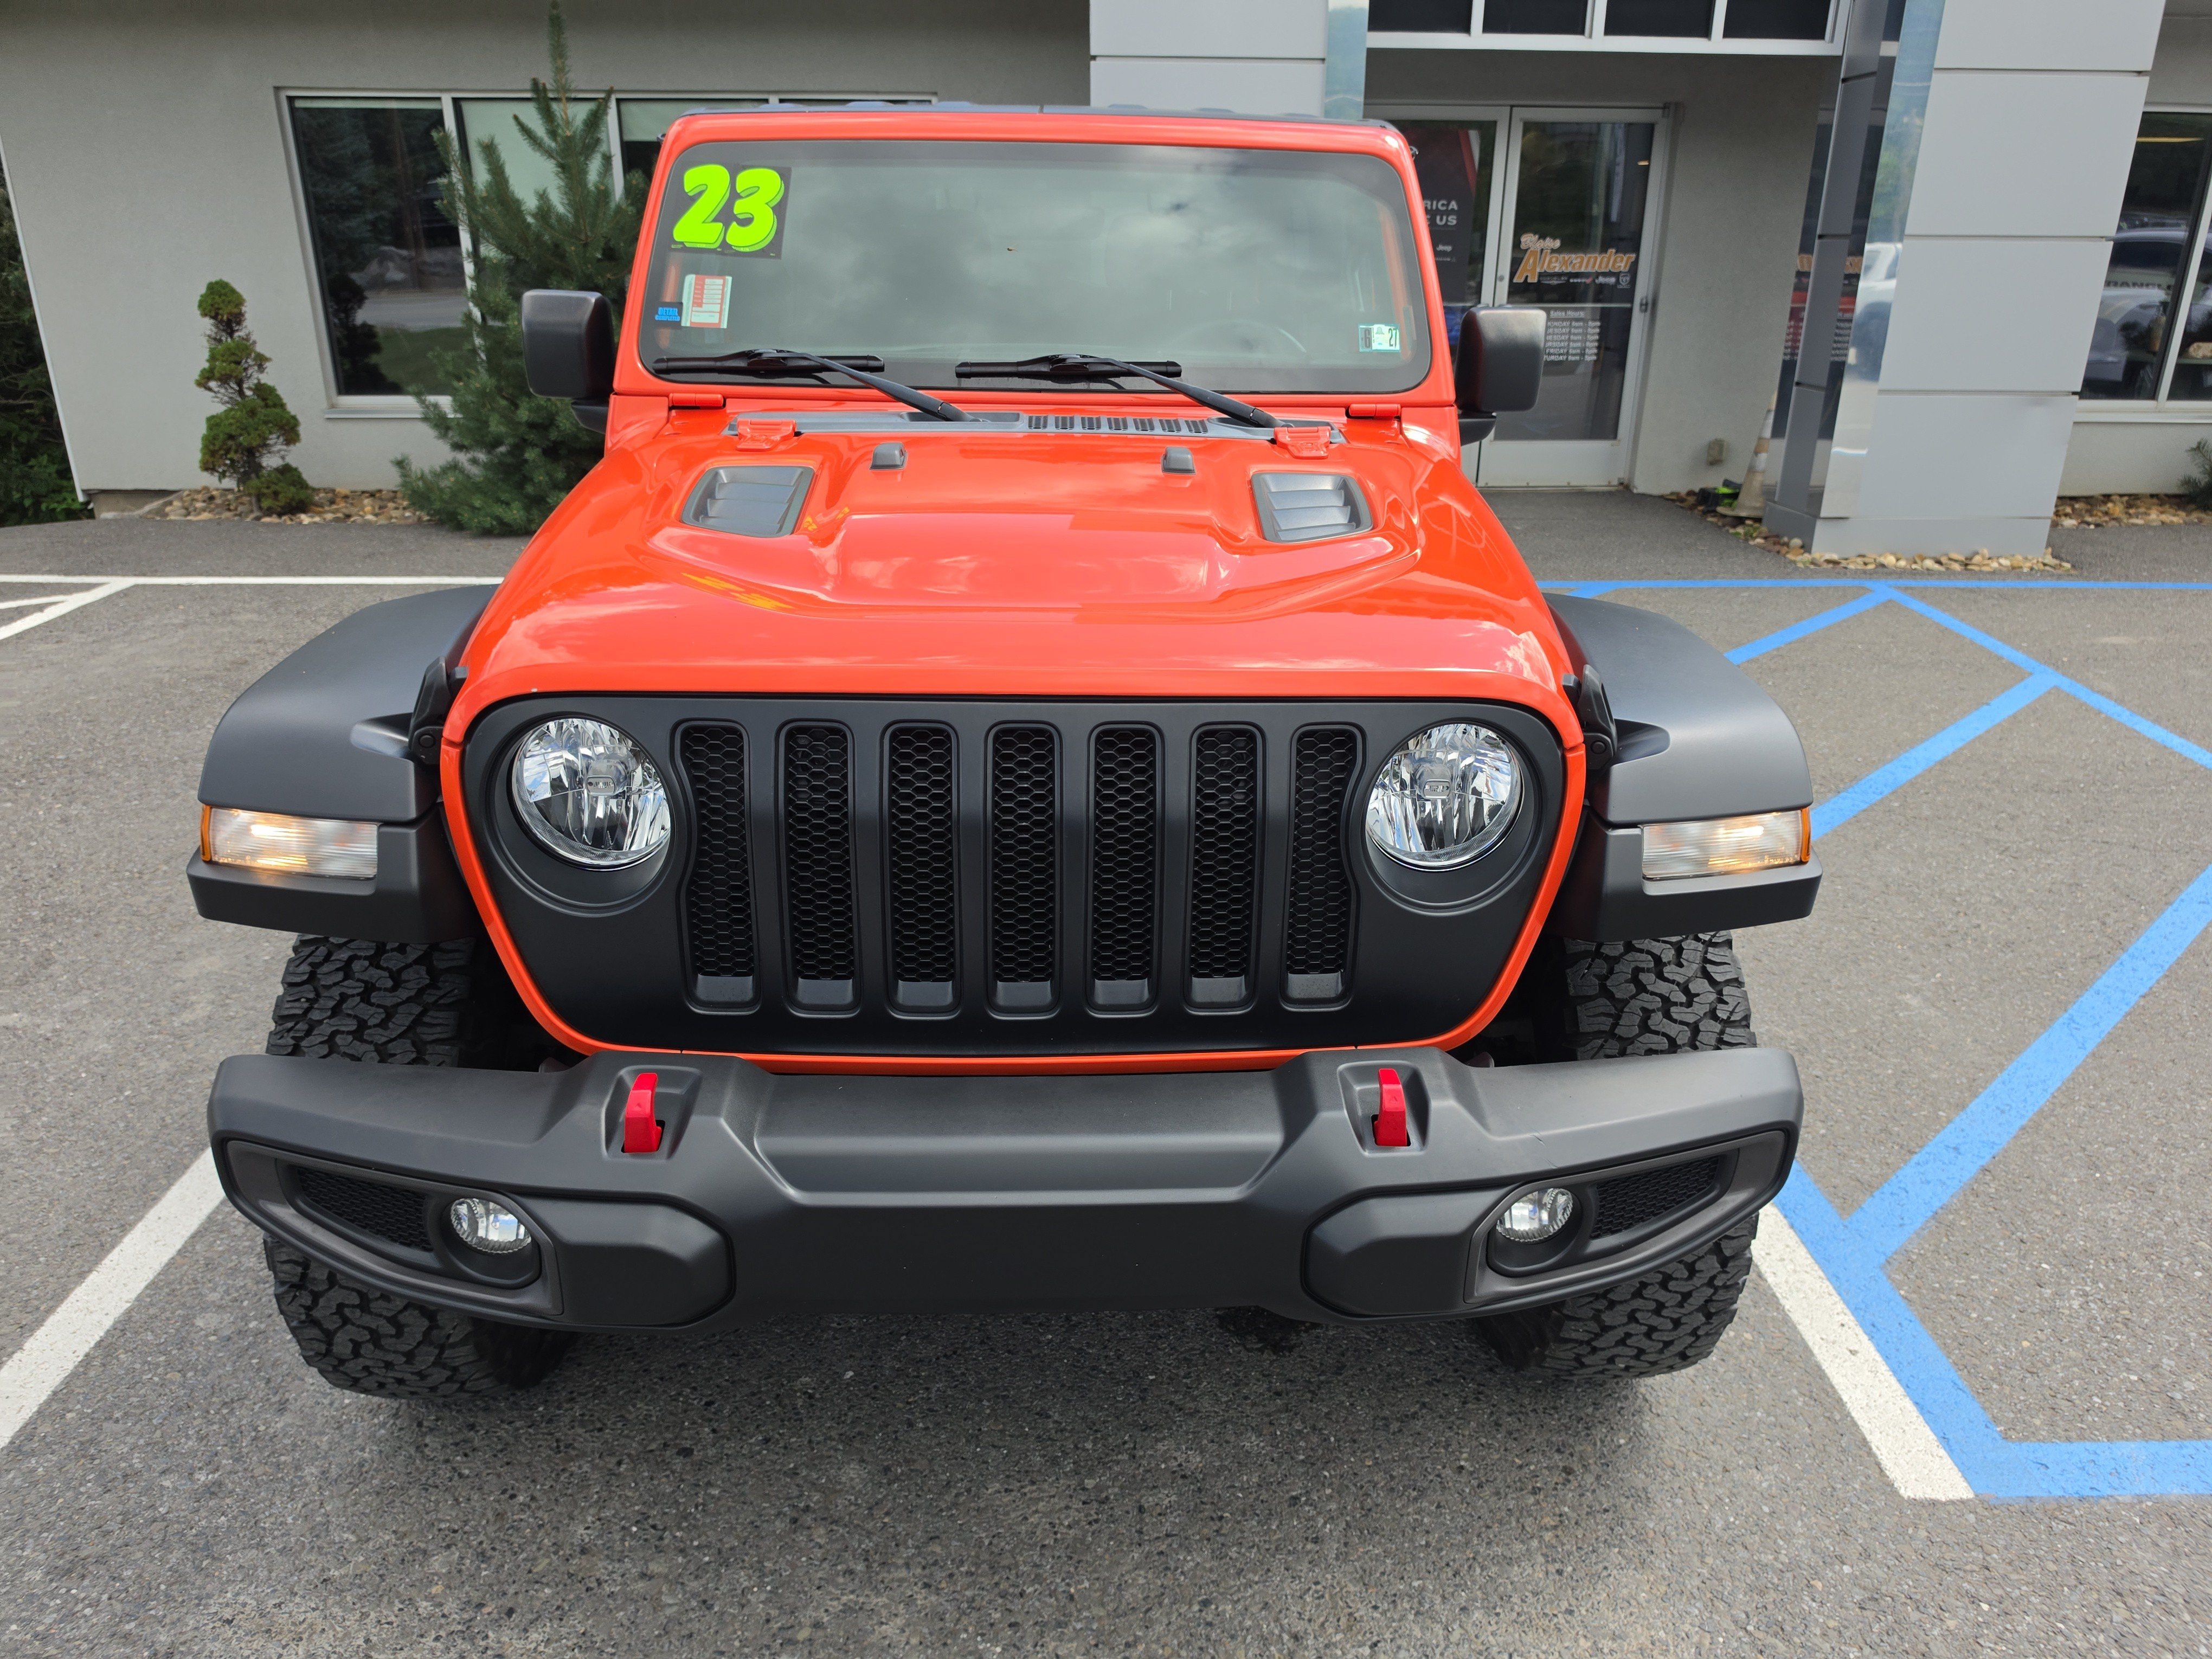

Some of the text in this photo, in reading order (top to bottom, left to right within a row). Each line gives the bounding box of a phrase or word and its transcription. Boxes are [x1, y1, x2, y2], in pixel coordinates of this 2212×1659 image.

[673, 164, 785, 252] 23
[1424, 200, 1458, 210] RICA
[1436, 215, 1457, 226] US
[1513, 248, 1636, 283] Alexander
[1364, 329, 1372, 349] 6
[1388, 328, 1398, 349] 27
